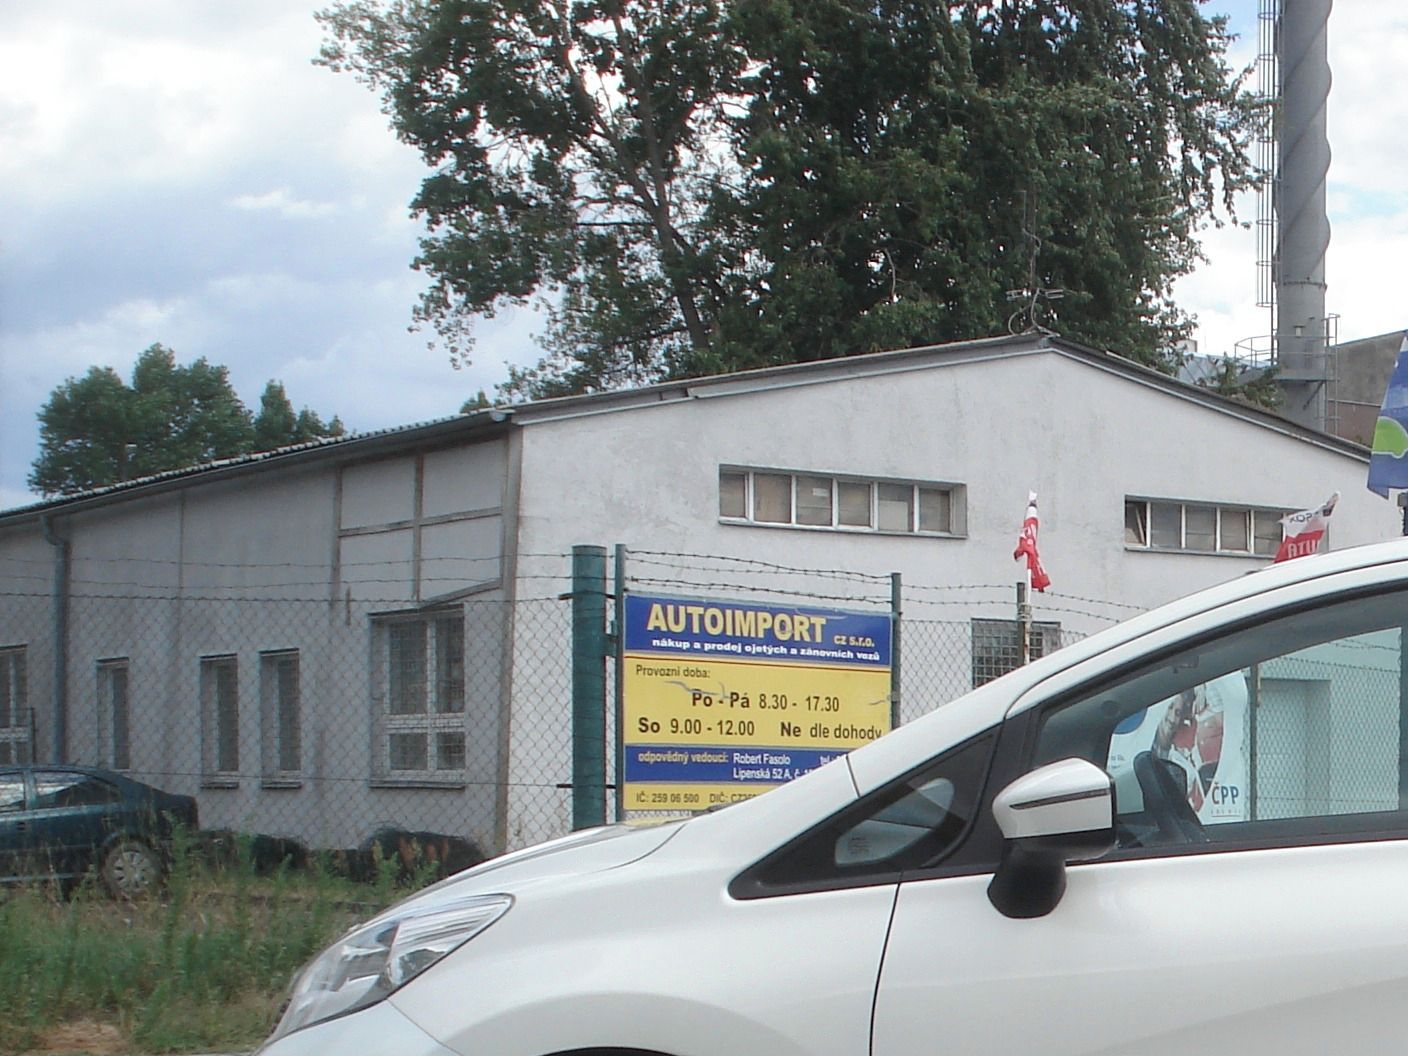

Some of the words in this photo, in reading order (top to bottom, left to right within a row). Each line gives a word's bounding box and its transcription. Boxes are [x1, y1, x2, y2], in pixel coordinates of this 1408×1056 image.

[647, 603, 827, 643] AUTOIMPORT
[849, 635, 876, 648] s.r.o.
[652, 638, 691, 650] nákup
[704, 642, 742, 653] prodej
[745, 644, 788, 655] ojetých
[800, 647, 854, 660] zánovních
[683, 667, 711, 678] doba:
[692, 688, 713, 707] Po
[730, 691, 751, 708] Pá
[759, 693, 788, 710] 8.30
[805, 696, 840, 712] 17.30
[638, 717, 660, 733] So
[670, 718, 702, 734] 9.00
[717, 720, 755, 736] 12.00
[780, 722, 801, 738] Ne
[810, 723, 830, 738] dle
[834, 724, 882, 741] dohody
[733, 752, 762, 765] Robert
[1211, 781, 1239, 805] ČPP
